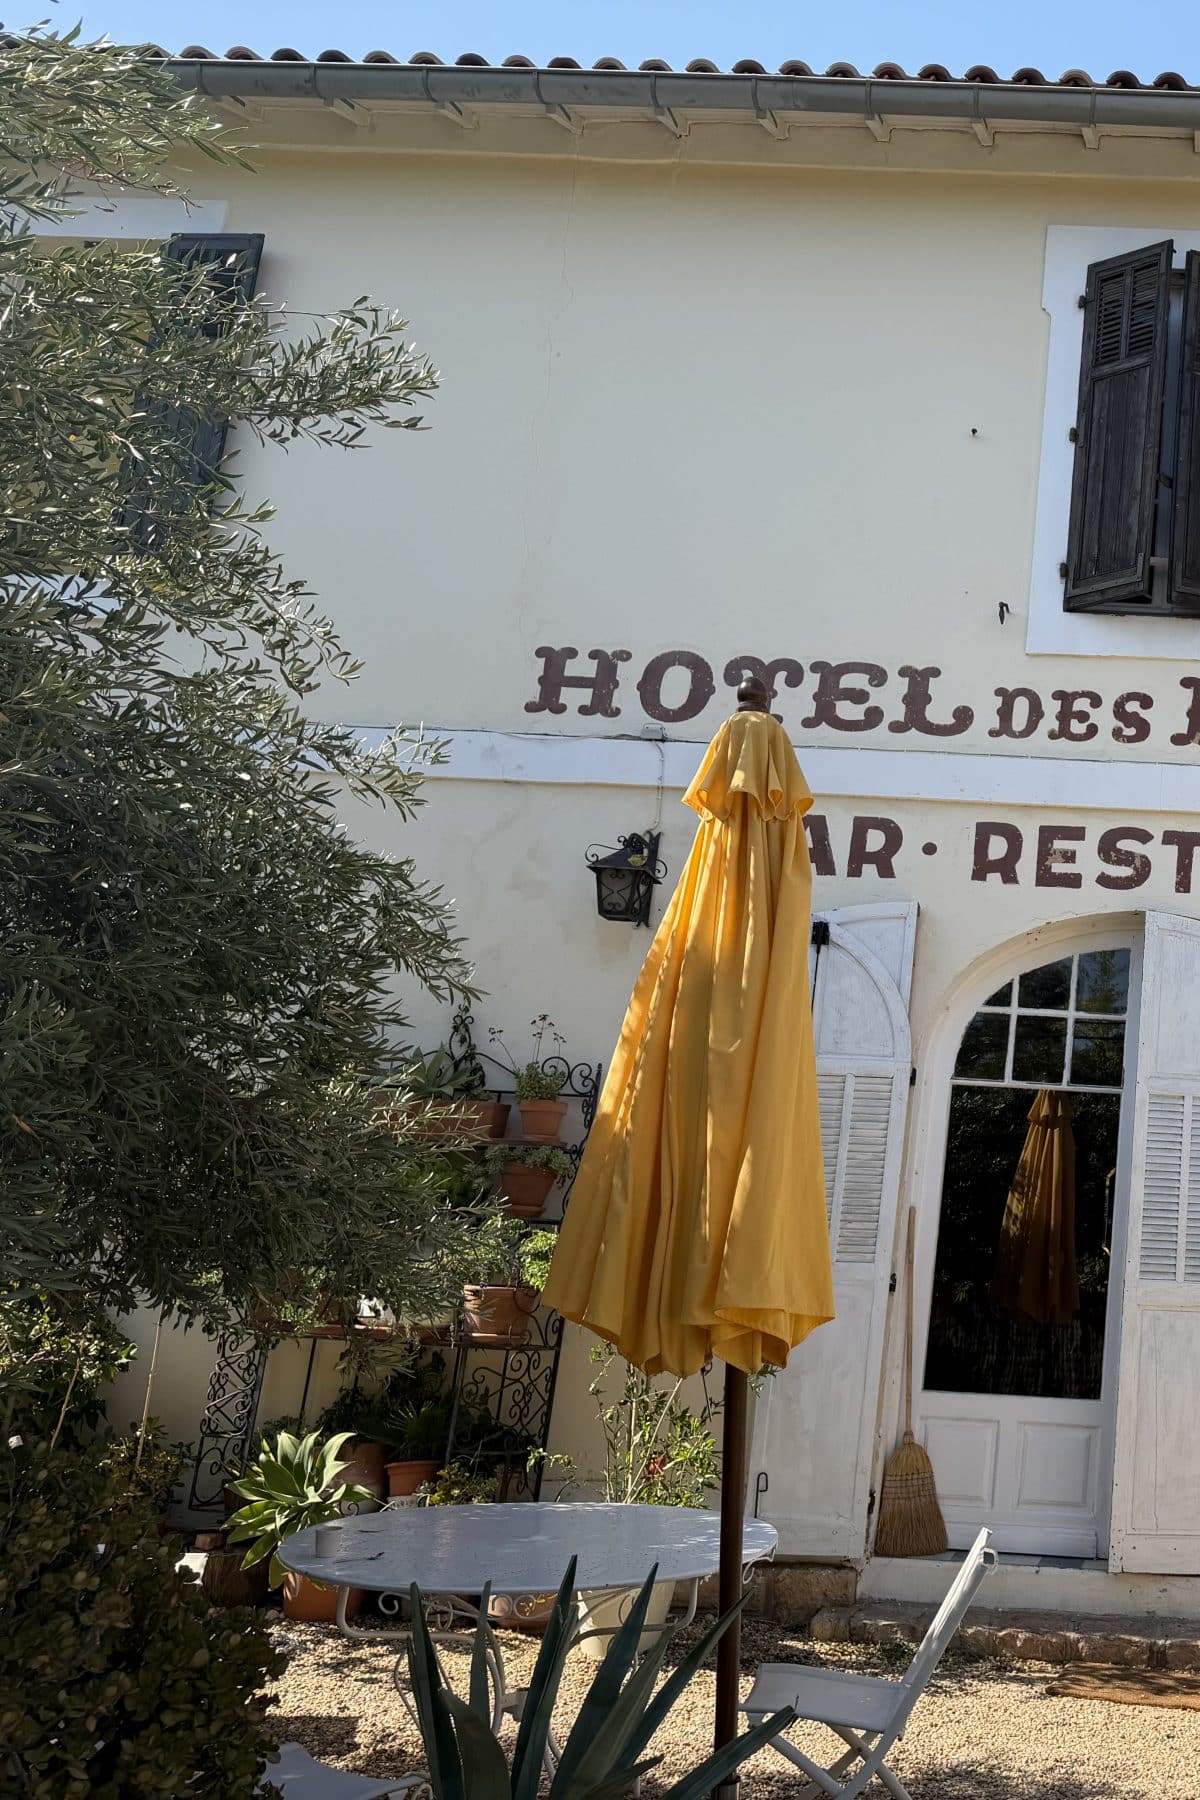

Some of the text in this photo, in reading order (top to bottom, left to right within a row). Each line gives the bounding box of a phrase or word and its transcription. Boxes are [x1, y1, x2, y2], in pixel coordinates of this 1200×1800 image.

[524, 645, 974, 736] HOTEL
[987, 686, 1153, 744] DES
[803, 814, 903, 878] AR
